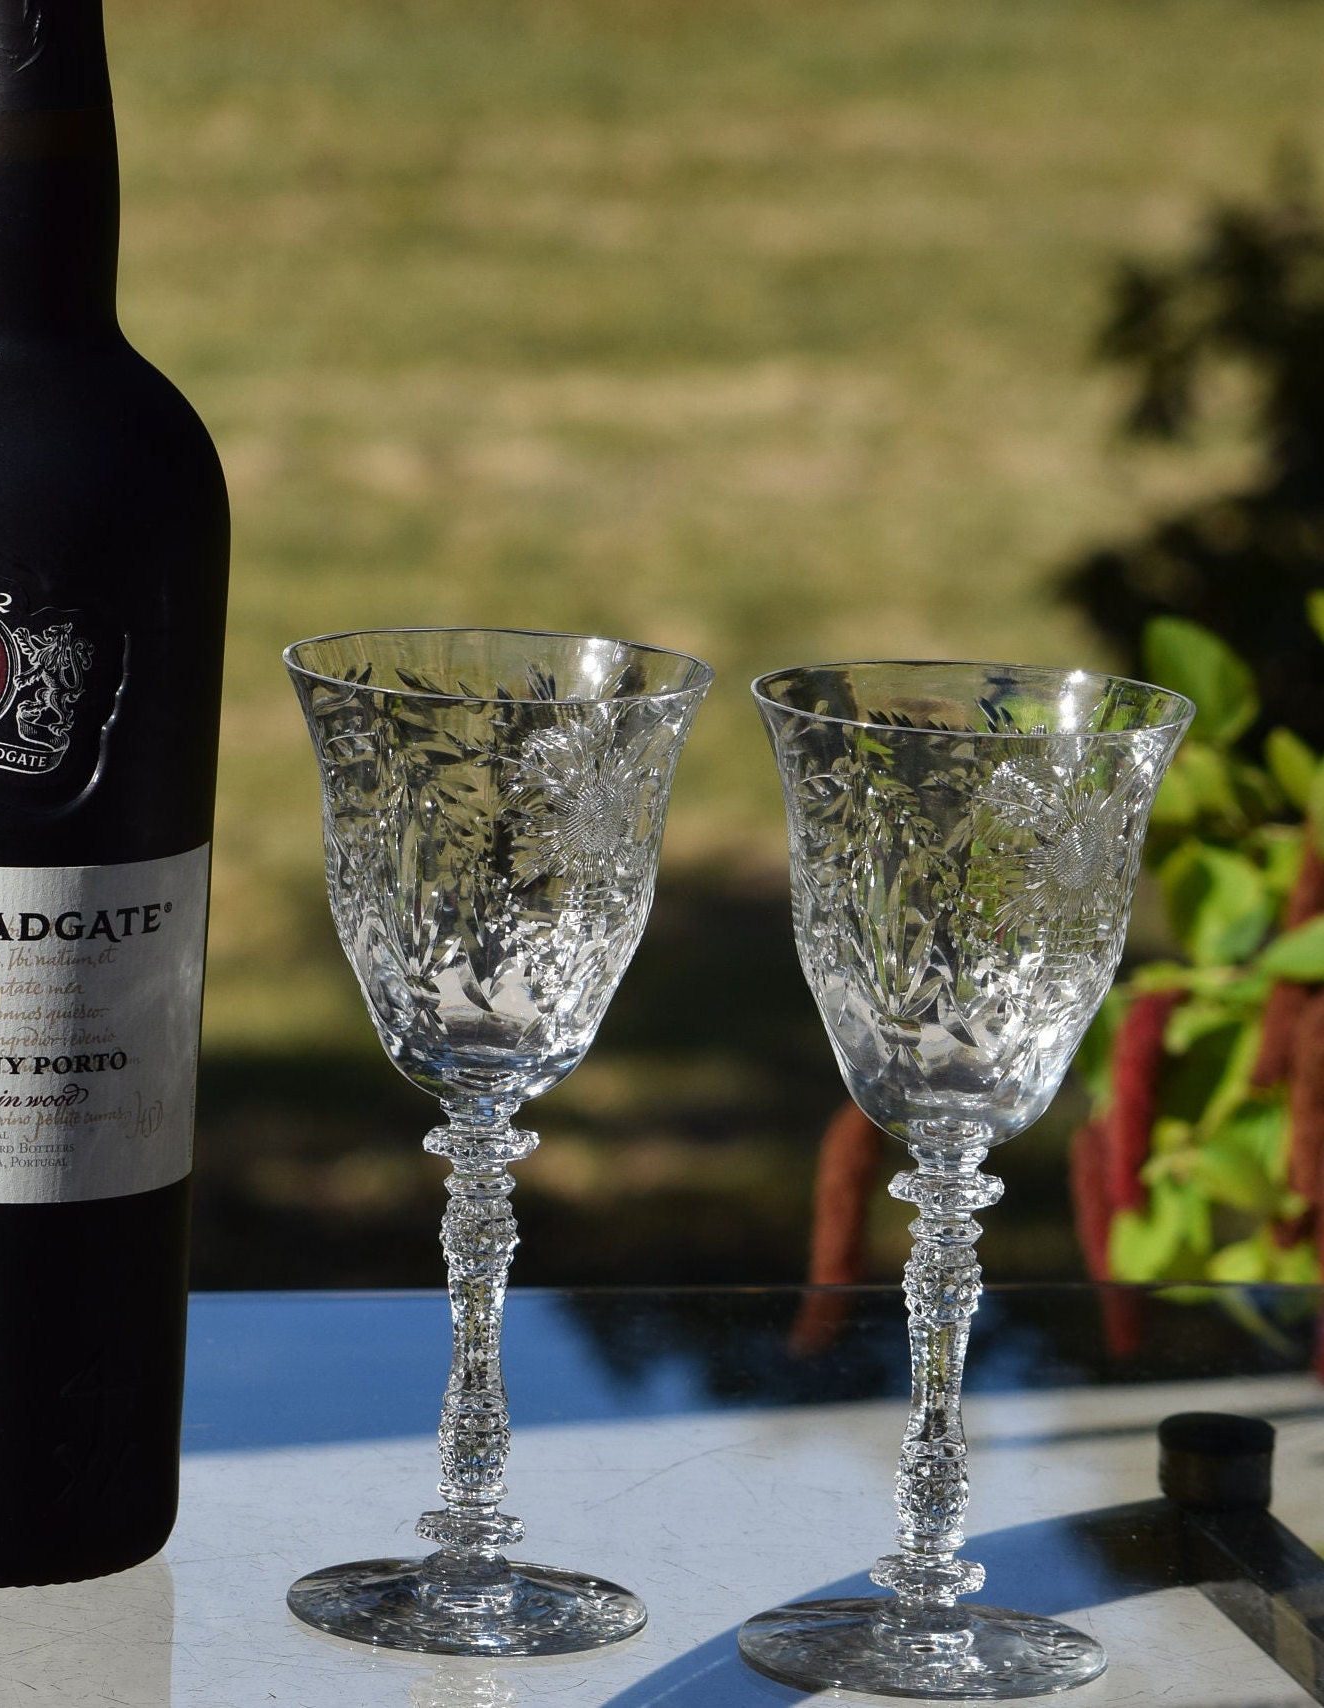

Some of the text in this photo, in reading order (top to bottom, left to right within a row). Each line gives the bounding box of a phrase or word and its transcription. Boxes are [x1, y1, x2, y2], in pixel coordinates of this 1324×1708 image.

[33, 1051, 128, 1075] PORTO
[25, 1083, 88, 1108] wood
[19, 1142, 75, 1154] BOTTLERS
[11, 1156, 68, 1168] PORTUGAL
